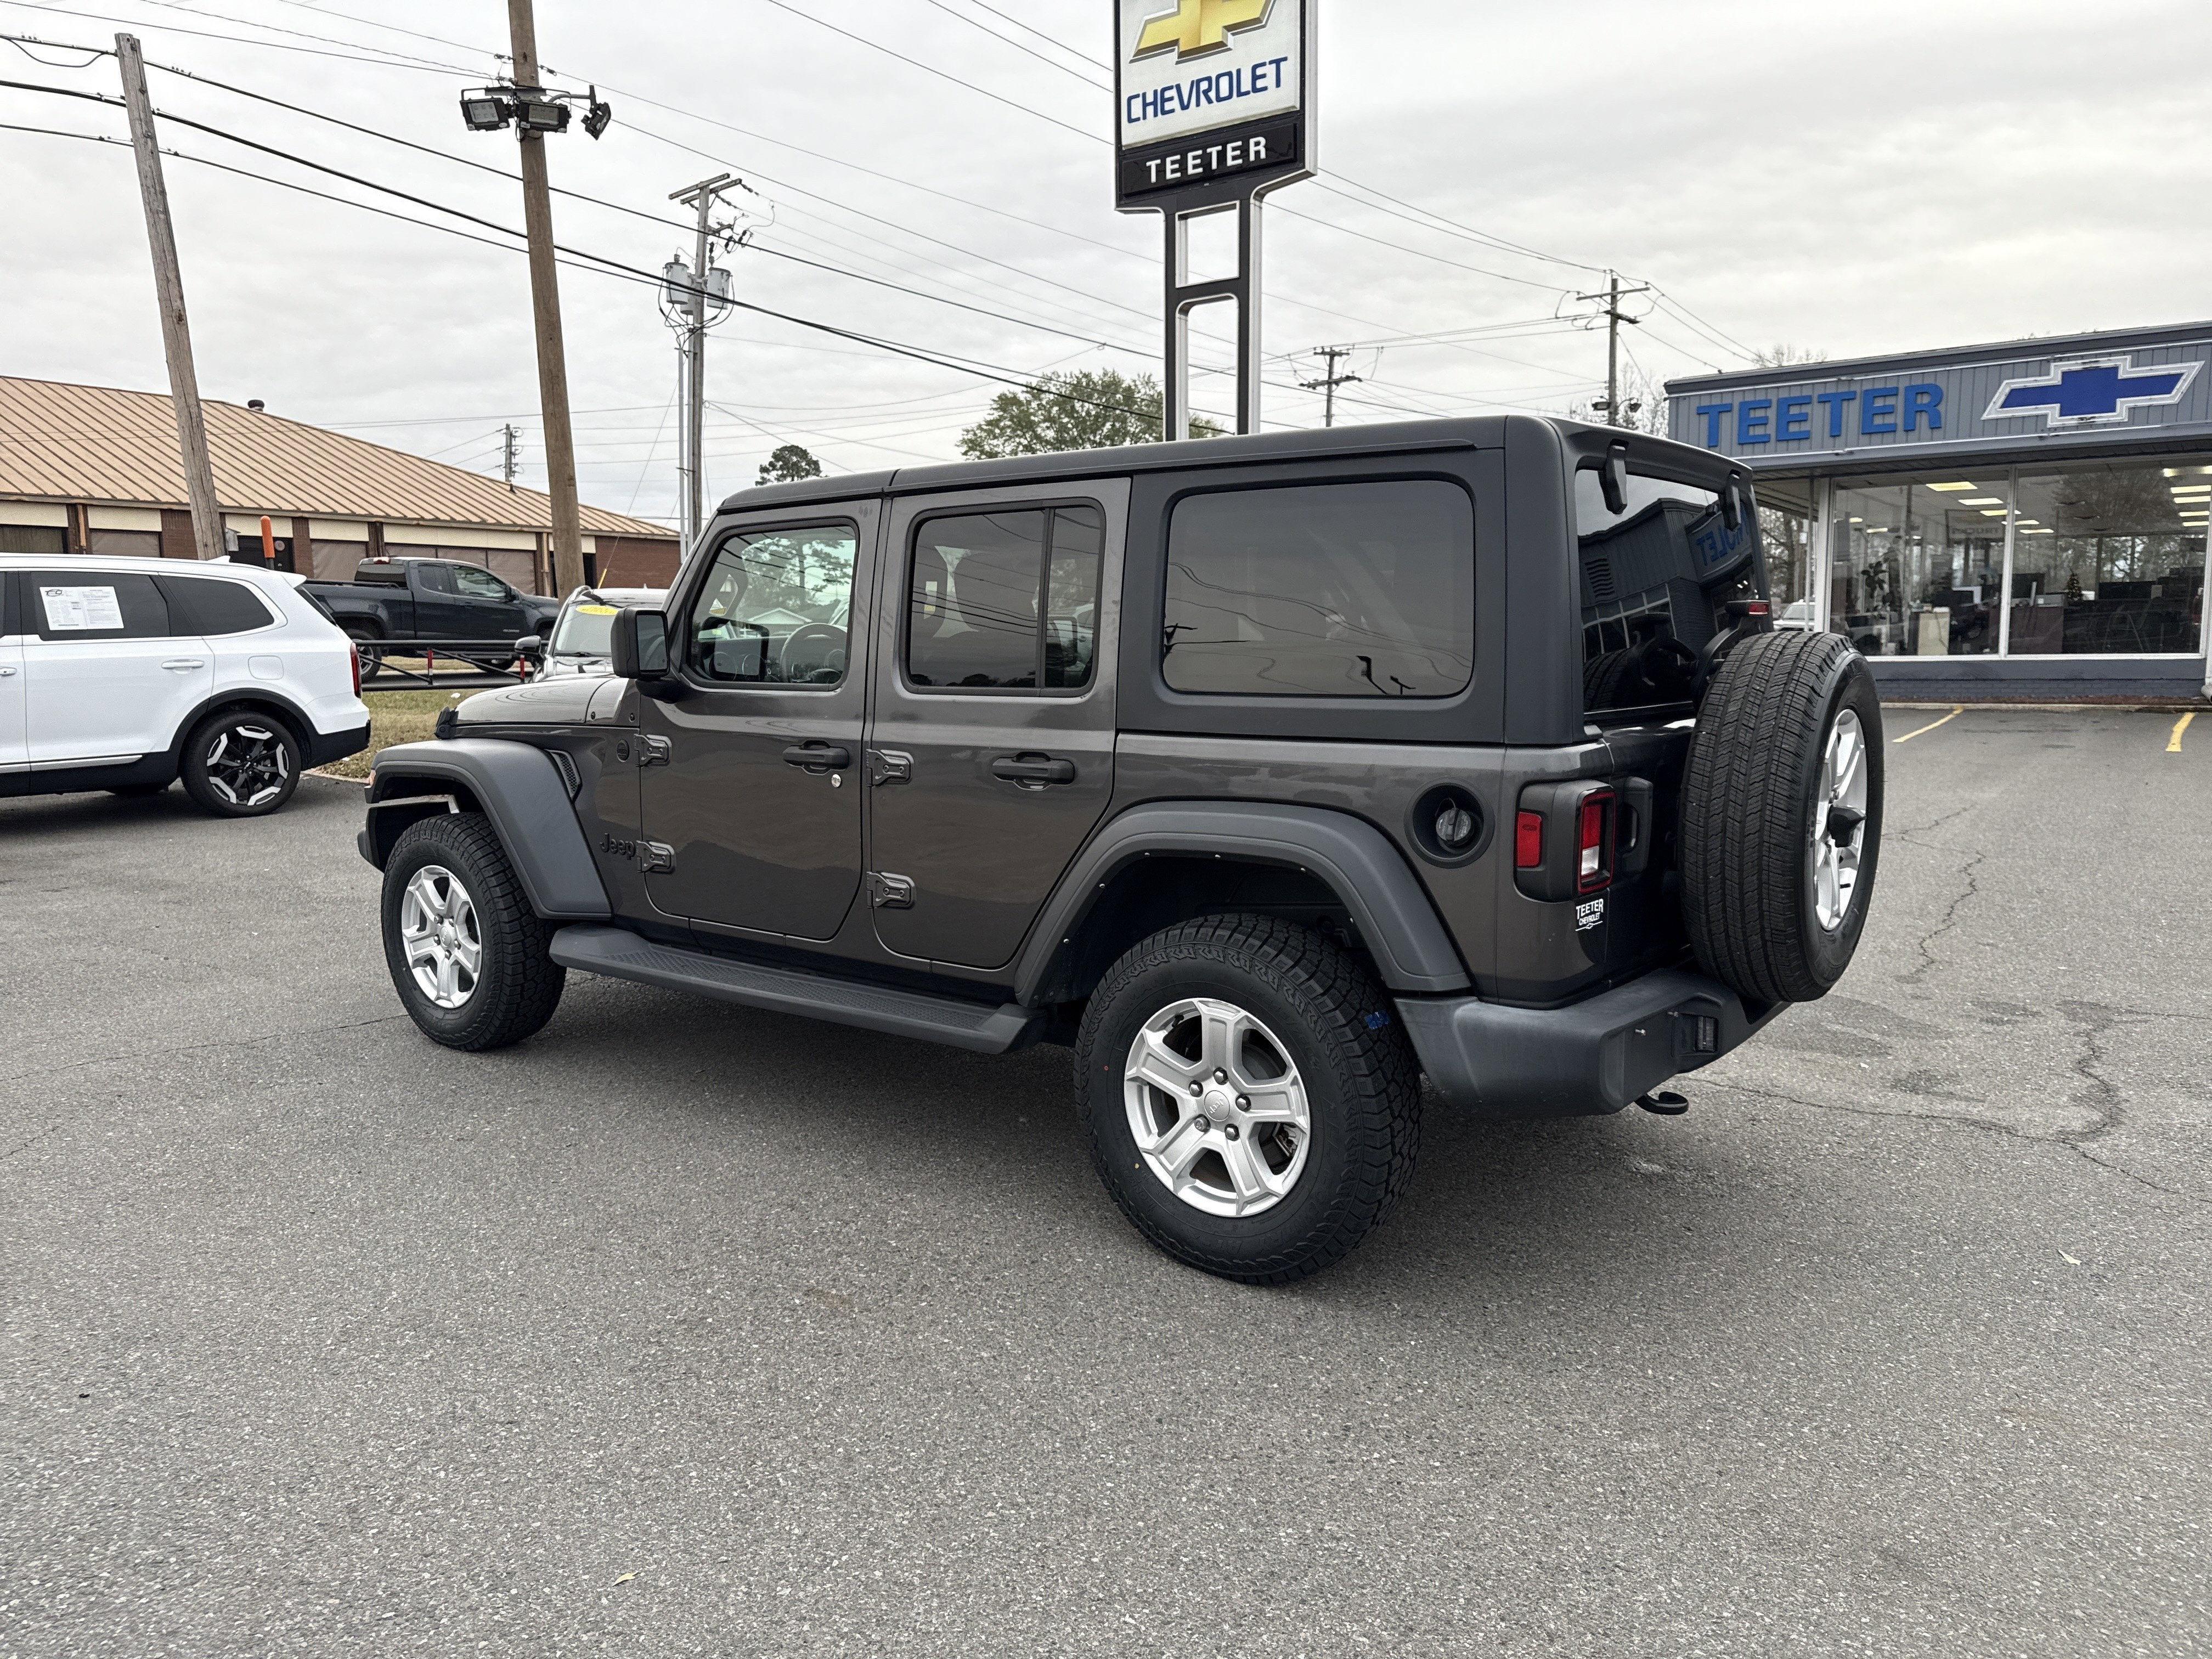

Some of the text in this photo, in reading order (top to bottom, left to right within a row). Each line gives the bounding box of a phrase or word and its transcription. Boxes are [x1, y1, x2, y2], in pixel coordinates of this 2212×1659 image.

[1126, 56, 1288, 124] CHEVROLET
[1146, 136, 1267, 184] TEETER
[1696, 382, 1944, 448] TEETER
[599, 832, 636, 861] Jeep
[1576, 898, 1604, 920] TEETER
